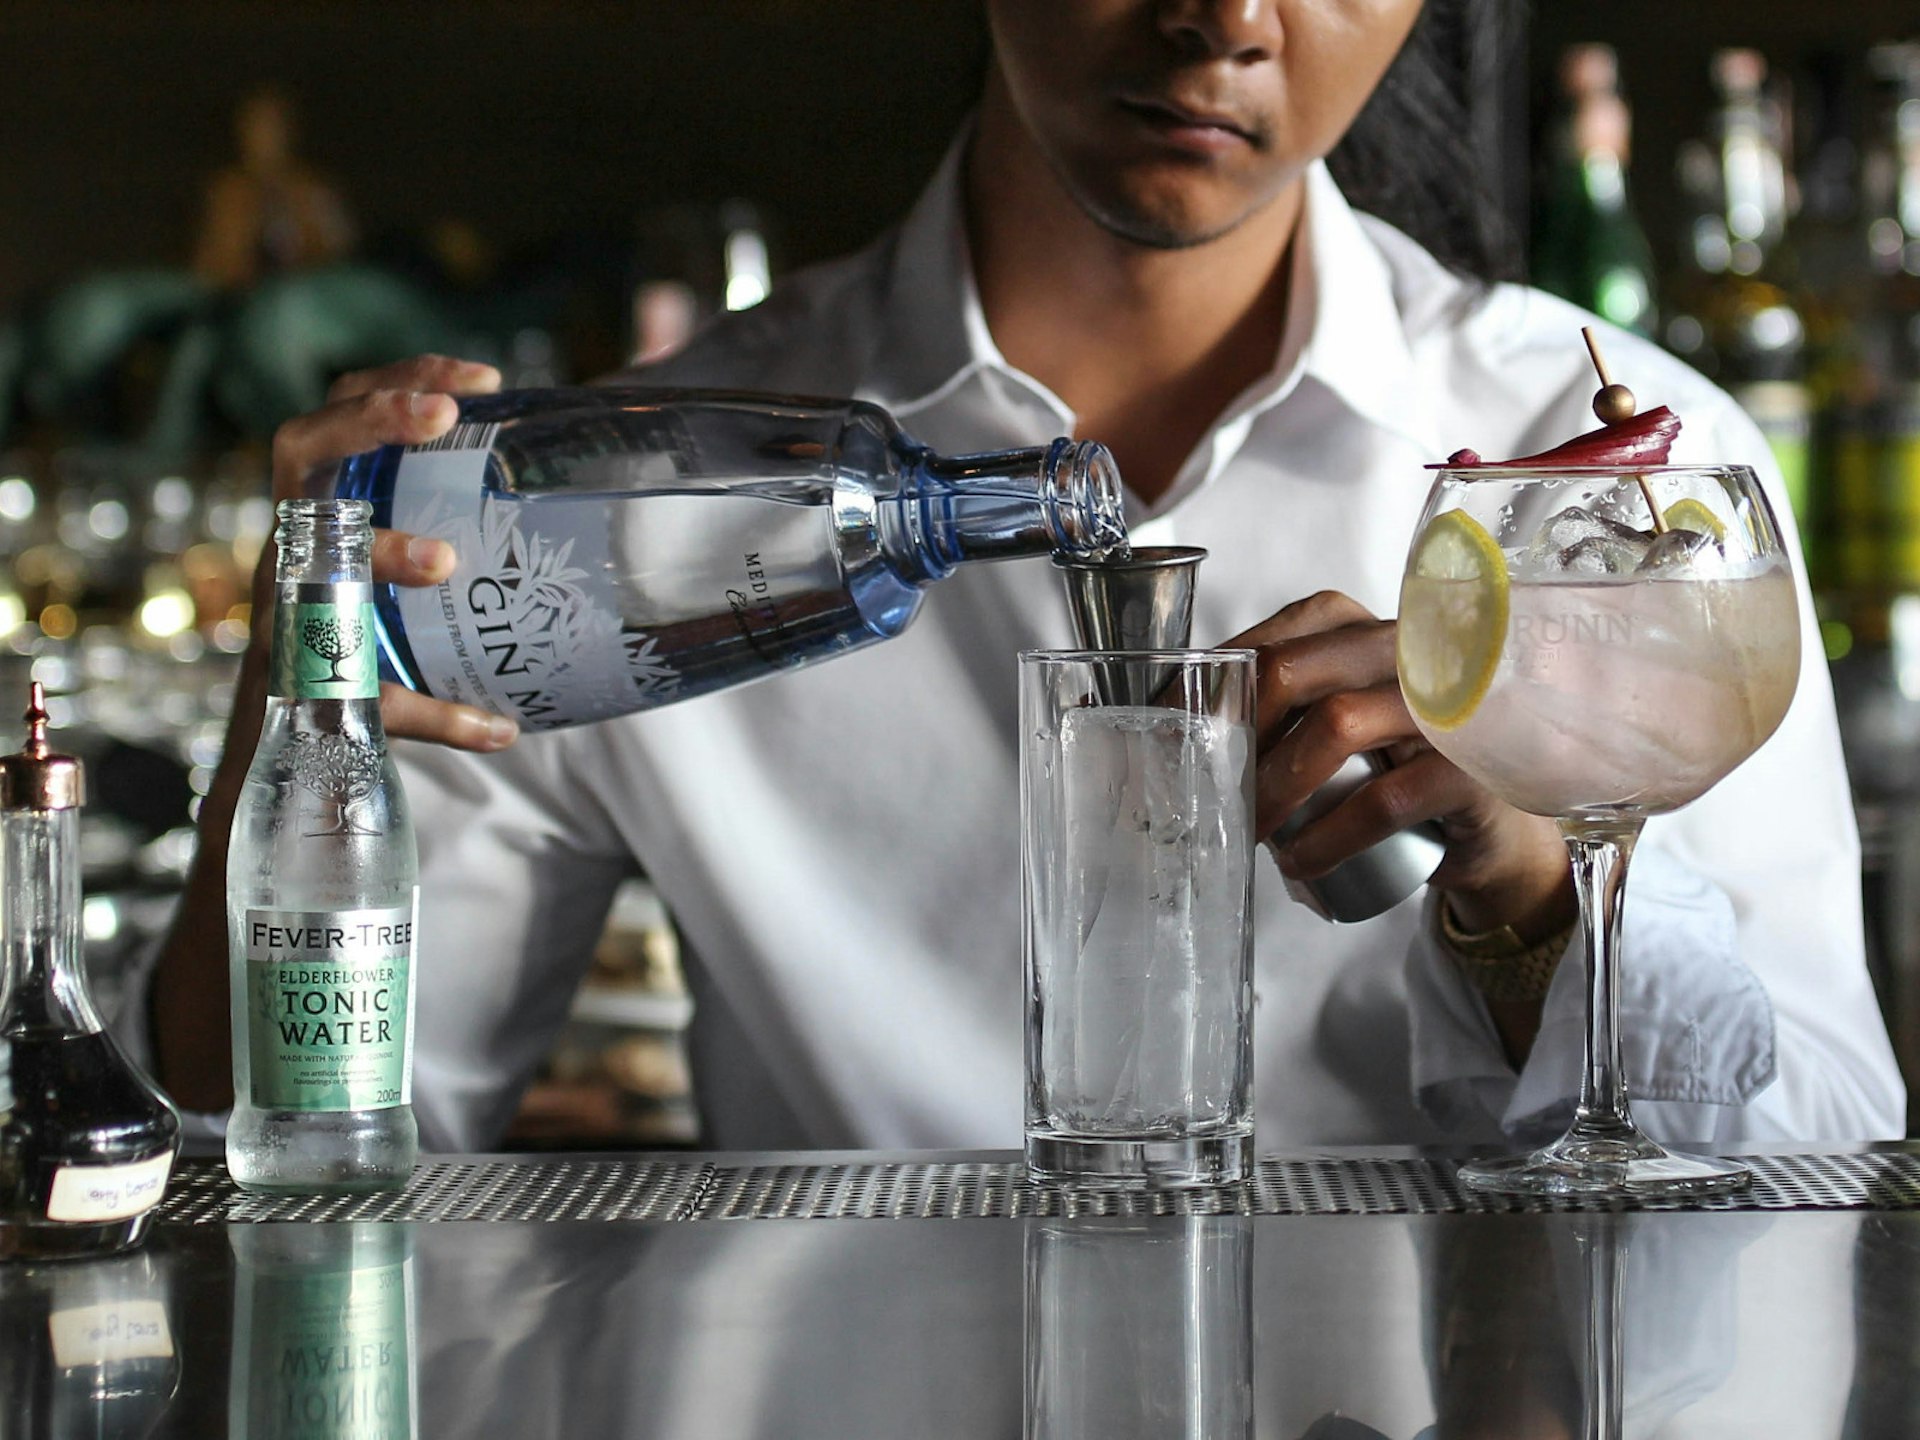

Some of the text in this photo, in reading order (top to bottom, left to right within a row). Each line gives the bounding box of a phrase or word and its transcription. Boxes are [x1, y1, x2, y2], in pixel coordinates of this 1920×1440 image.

[467, 576, 530, 678] GIN
[252, 922, 412, 949] FEVER-TREE
[279, 968, 395, 985] ELDERFLOWER
[281, 988, 390, 1015] TONIC
[279, 1019, 393, 1046] WATER
[304, 1055, 326, 1063] WITH
